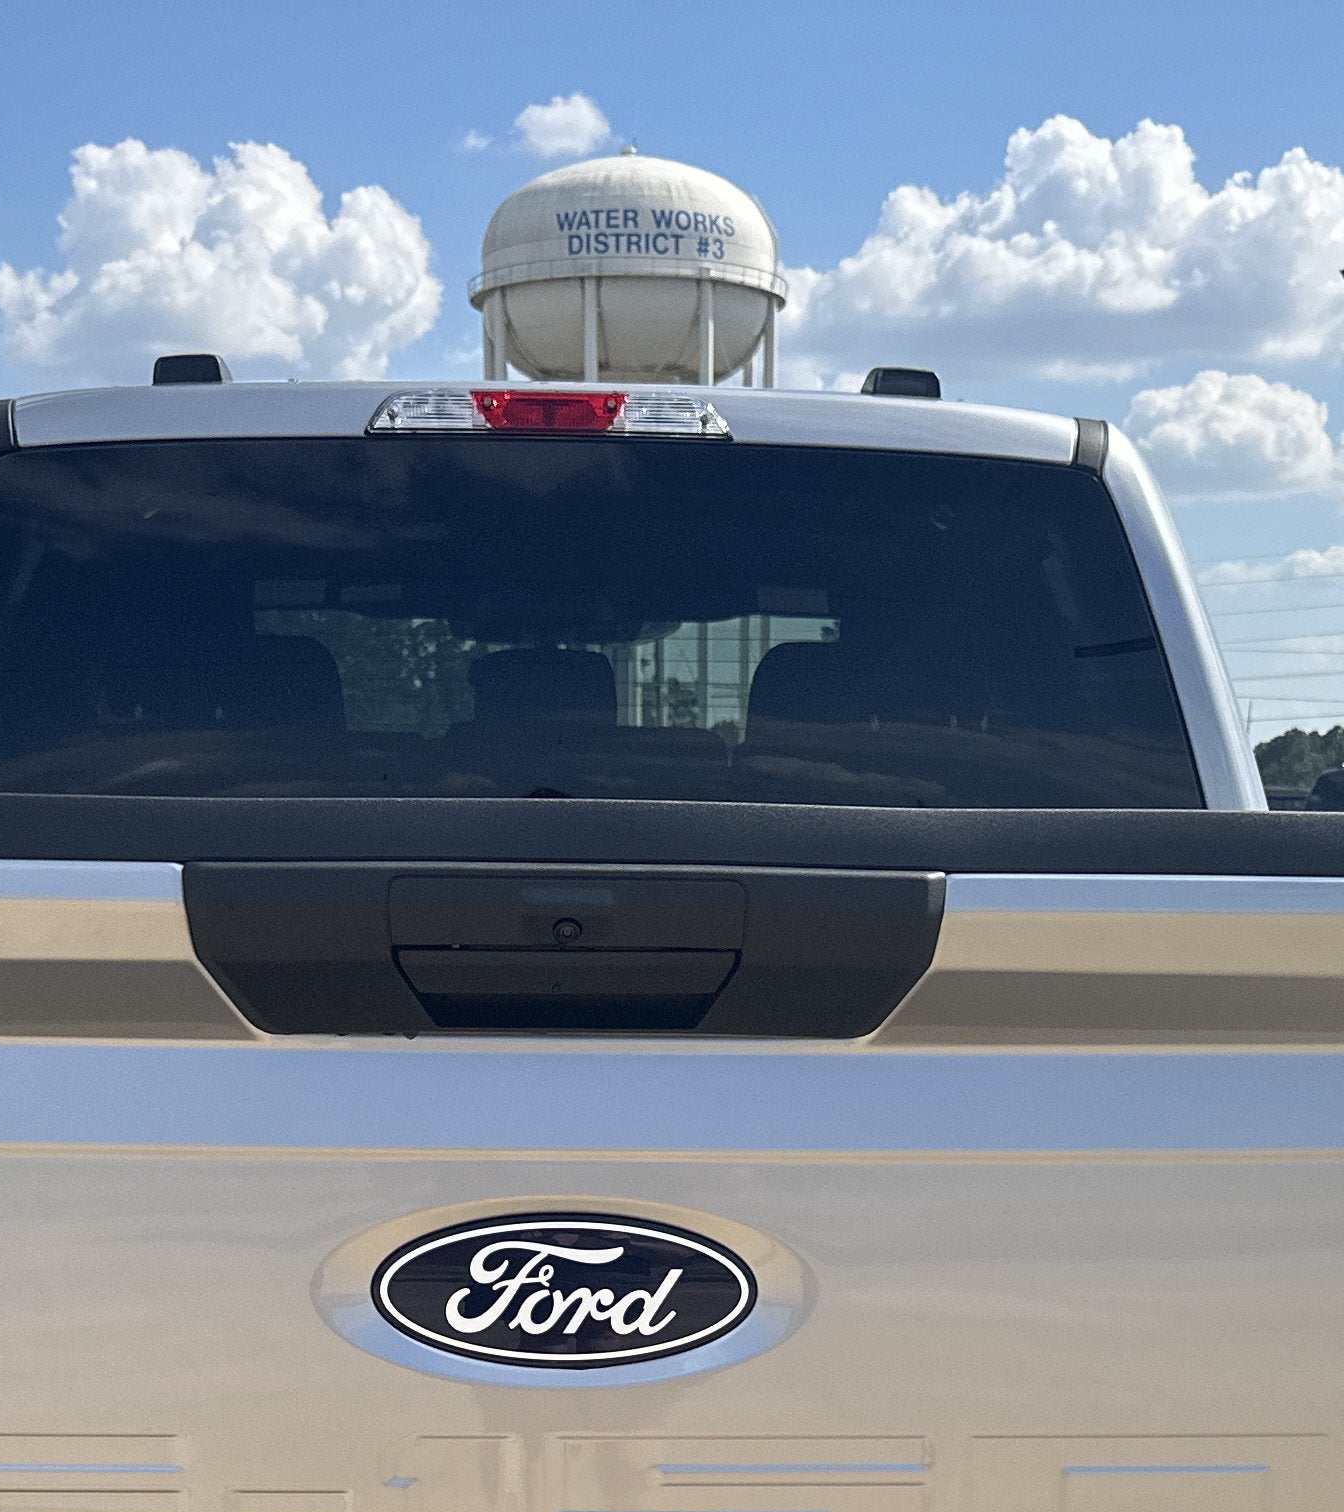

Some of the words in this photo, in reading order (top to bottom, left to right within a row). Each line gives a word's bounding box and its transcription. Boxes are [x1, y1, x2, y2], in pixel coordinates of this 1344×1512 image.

[556, 208, 639, 232] WATER
[651, 209, 736, 238] WORKS
[567, 232, 682, 256] DISTRICT
[696, 237, 726, 260] #3
[445, 1240, 684, 1336] Ford
